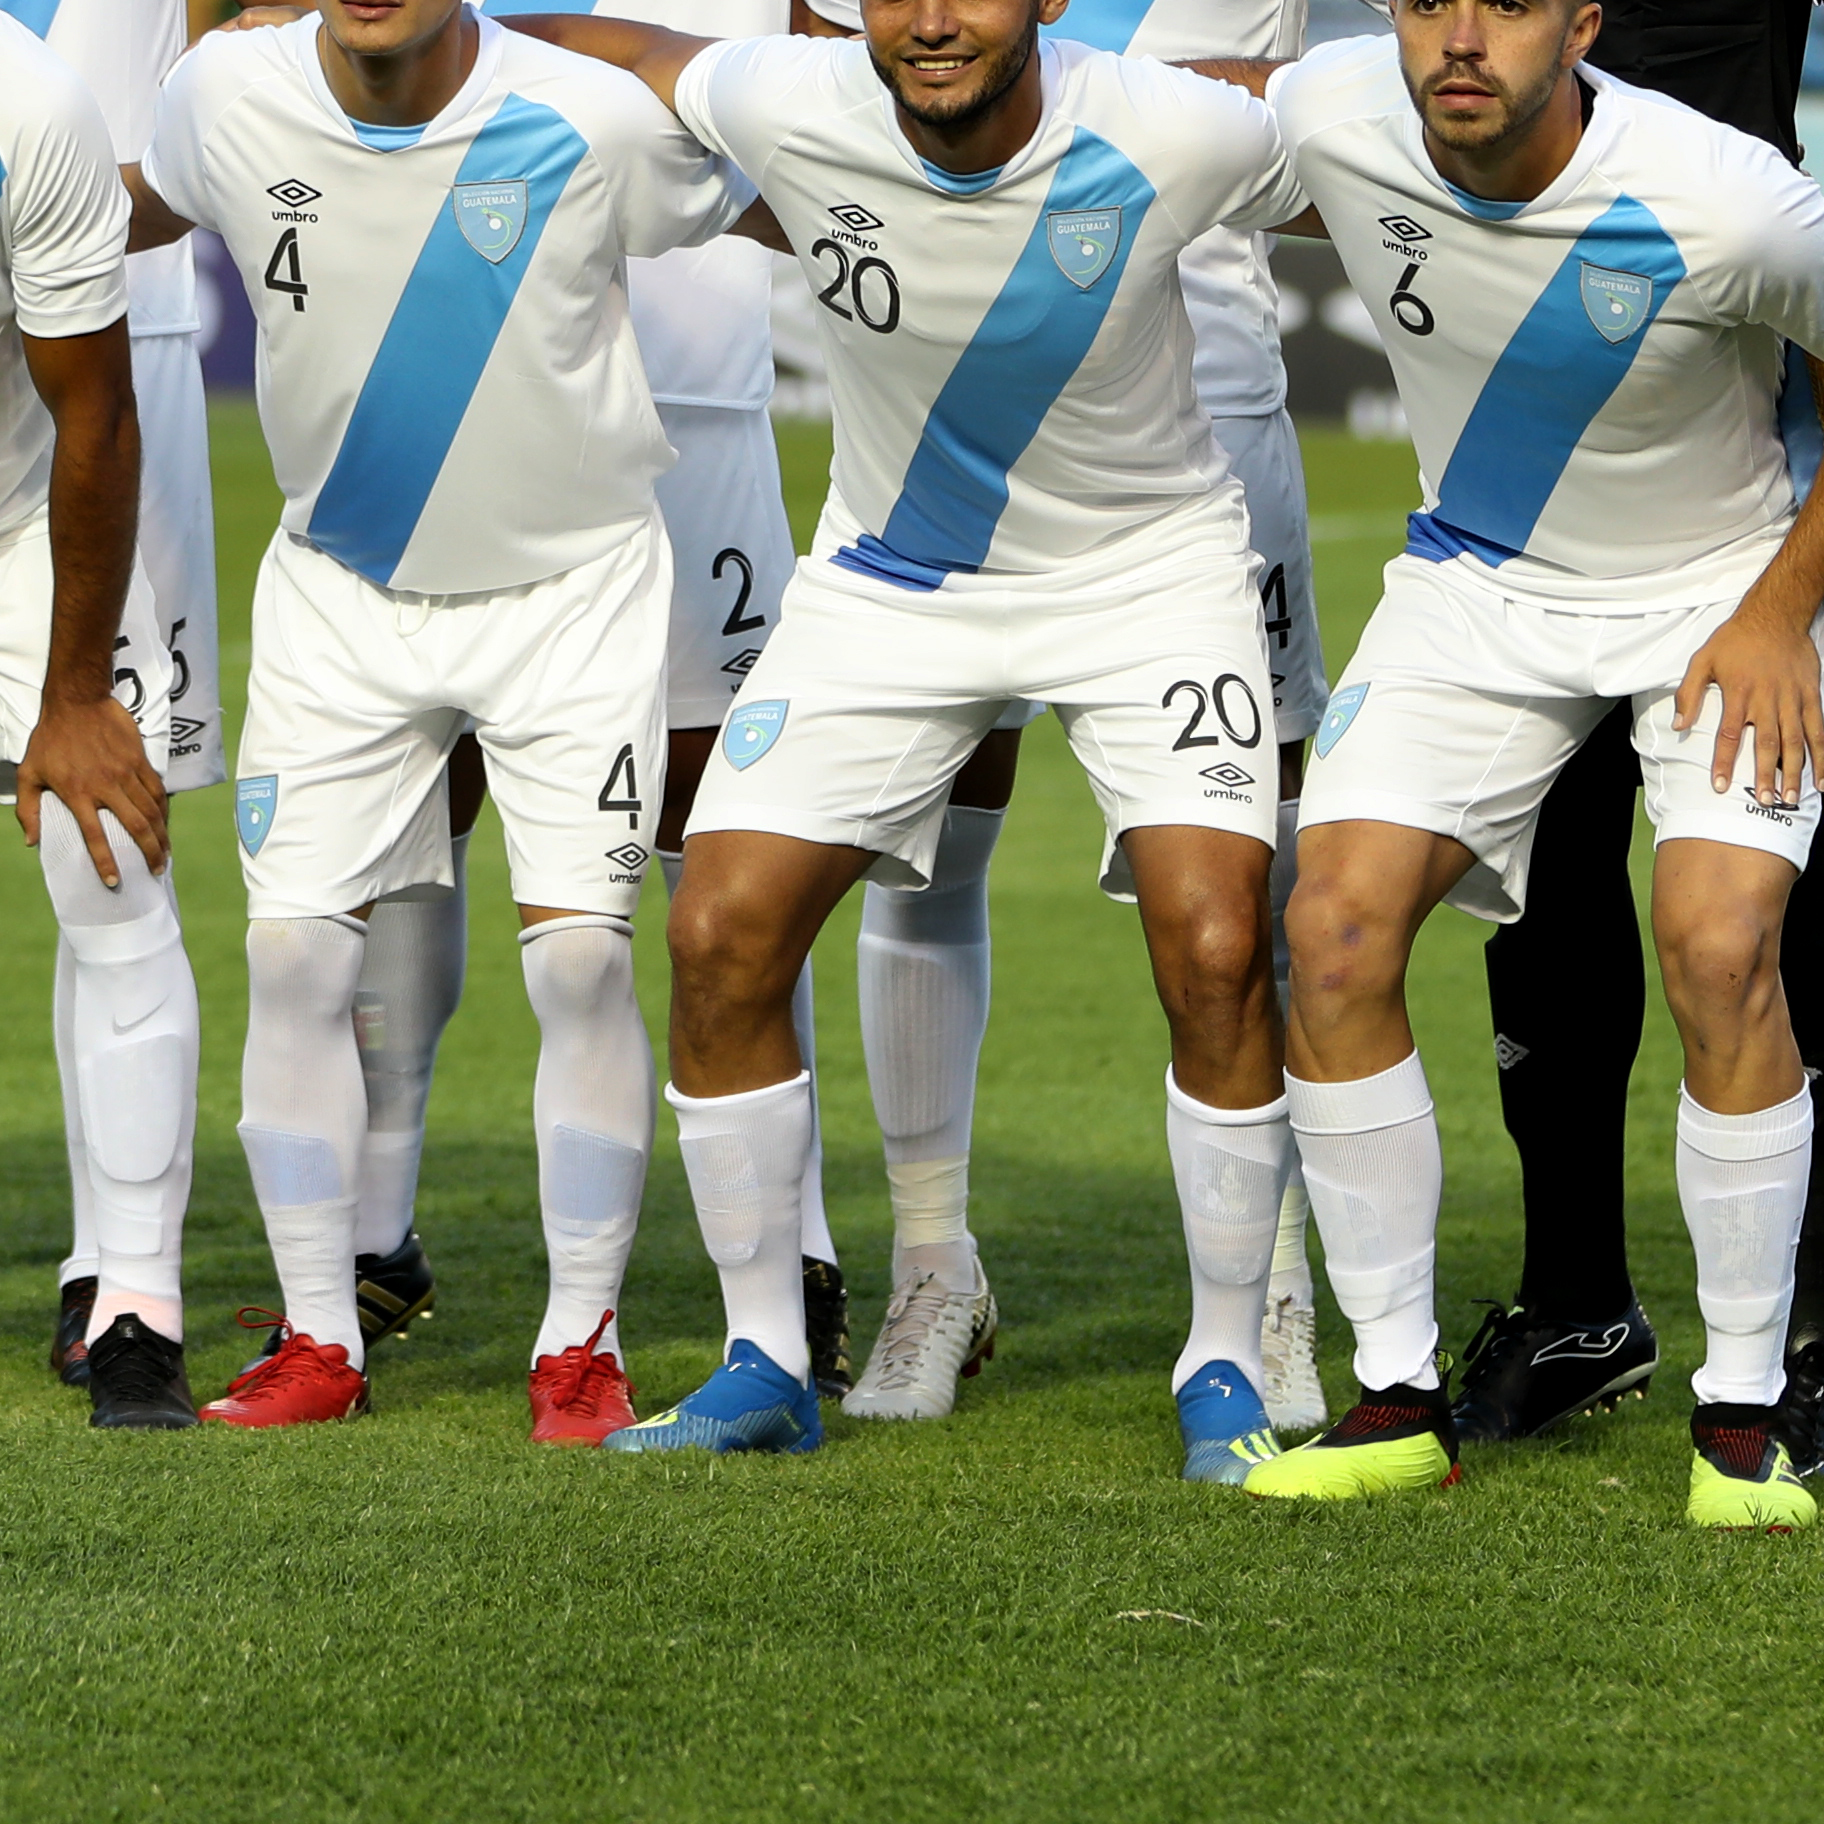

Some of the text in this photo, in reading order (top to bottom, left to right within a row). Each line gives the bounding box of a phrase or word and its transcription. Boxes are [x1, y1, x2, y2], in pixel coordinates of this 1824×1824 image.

[462, 194, 517, 208] GUATEMALA
[271, 210, 319, 224] umbro
[1056, 221, 1111, 235] GUATEMALA
[831, 229, 879, 251] umbro
[1382, 239, 1429, 261] umbro
[264, 227, 309, 313] 4
[811, 238, 901, 334] 20
[1588, 277, 1642, 295] GUATEMALA
[1389, 262, 1435, 337] 6
[711, 547, 767, 637] 2
[1161, 673, 1262, 753] 20
[598, 743, 642, 830] 4
[1203, 788, 1254, 804] umbro
[1745, 803, 1793, 827] umbro
